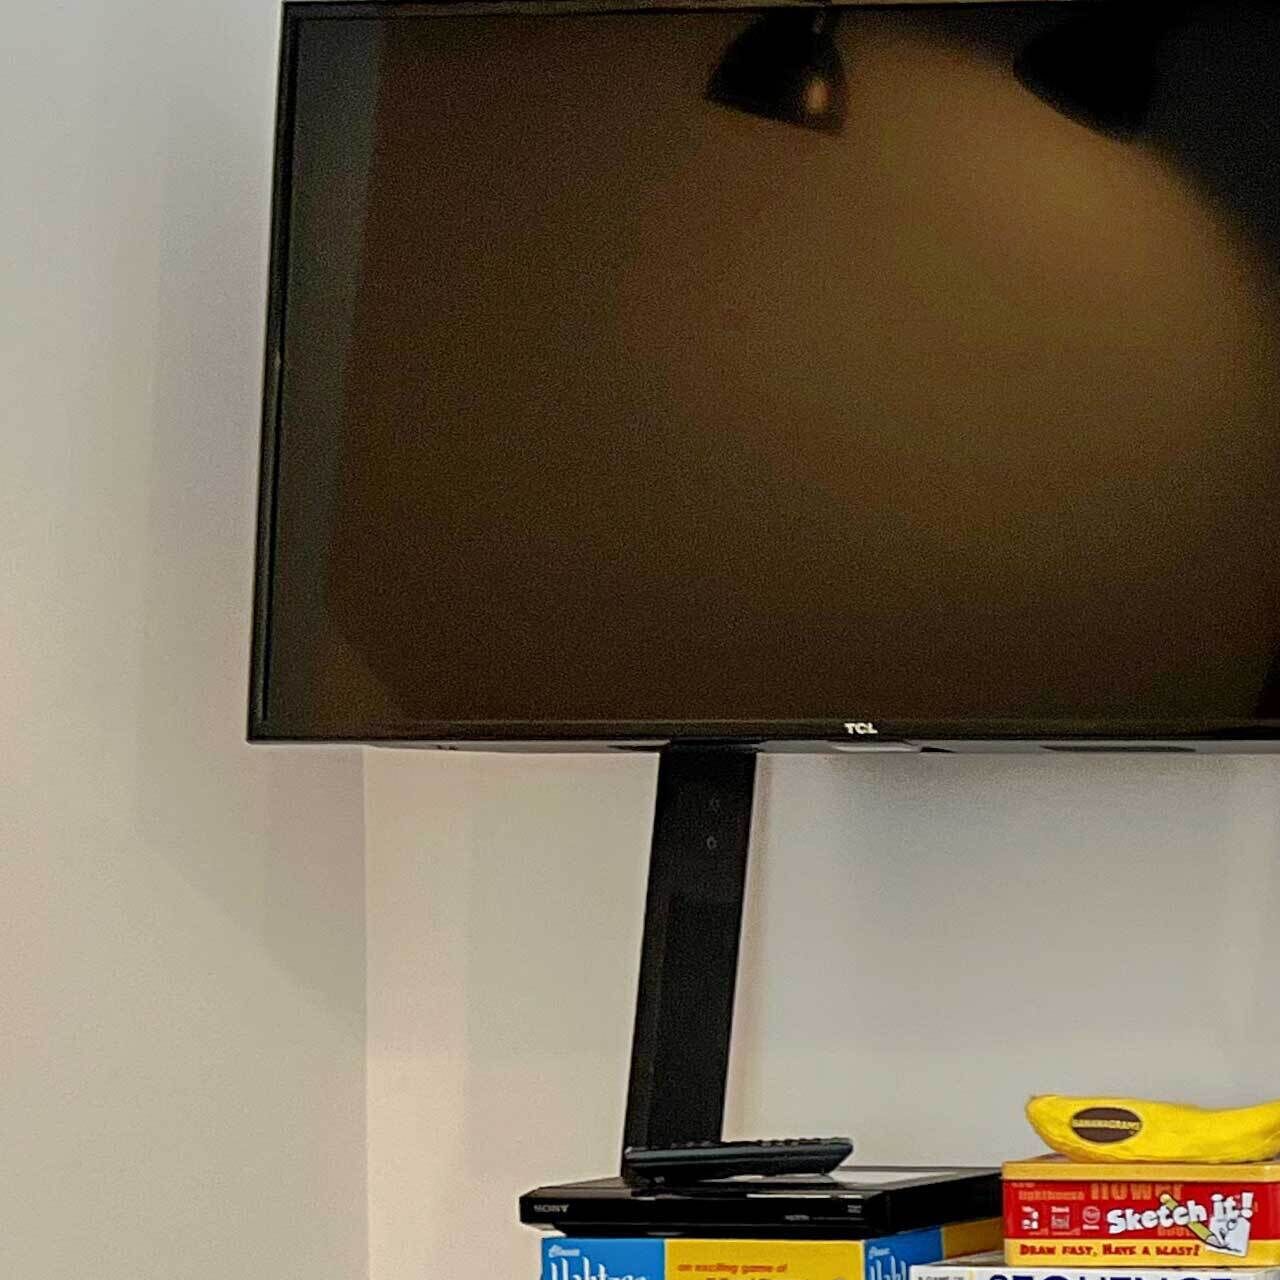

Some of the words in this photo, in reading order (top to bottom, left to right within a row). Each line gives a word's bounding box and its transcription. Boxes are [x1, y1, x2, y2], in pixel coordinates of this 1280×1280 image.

[844, 722, 878, 734] TCL
[1106, 1200, 1207, 1234] Sketch
[1211, 1192, 1254, 1219] it!
[1141, 1245, 1151, 1256] A
